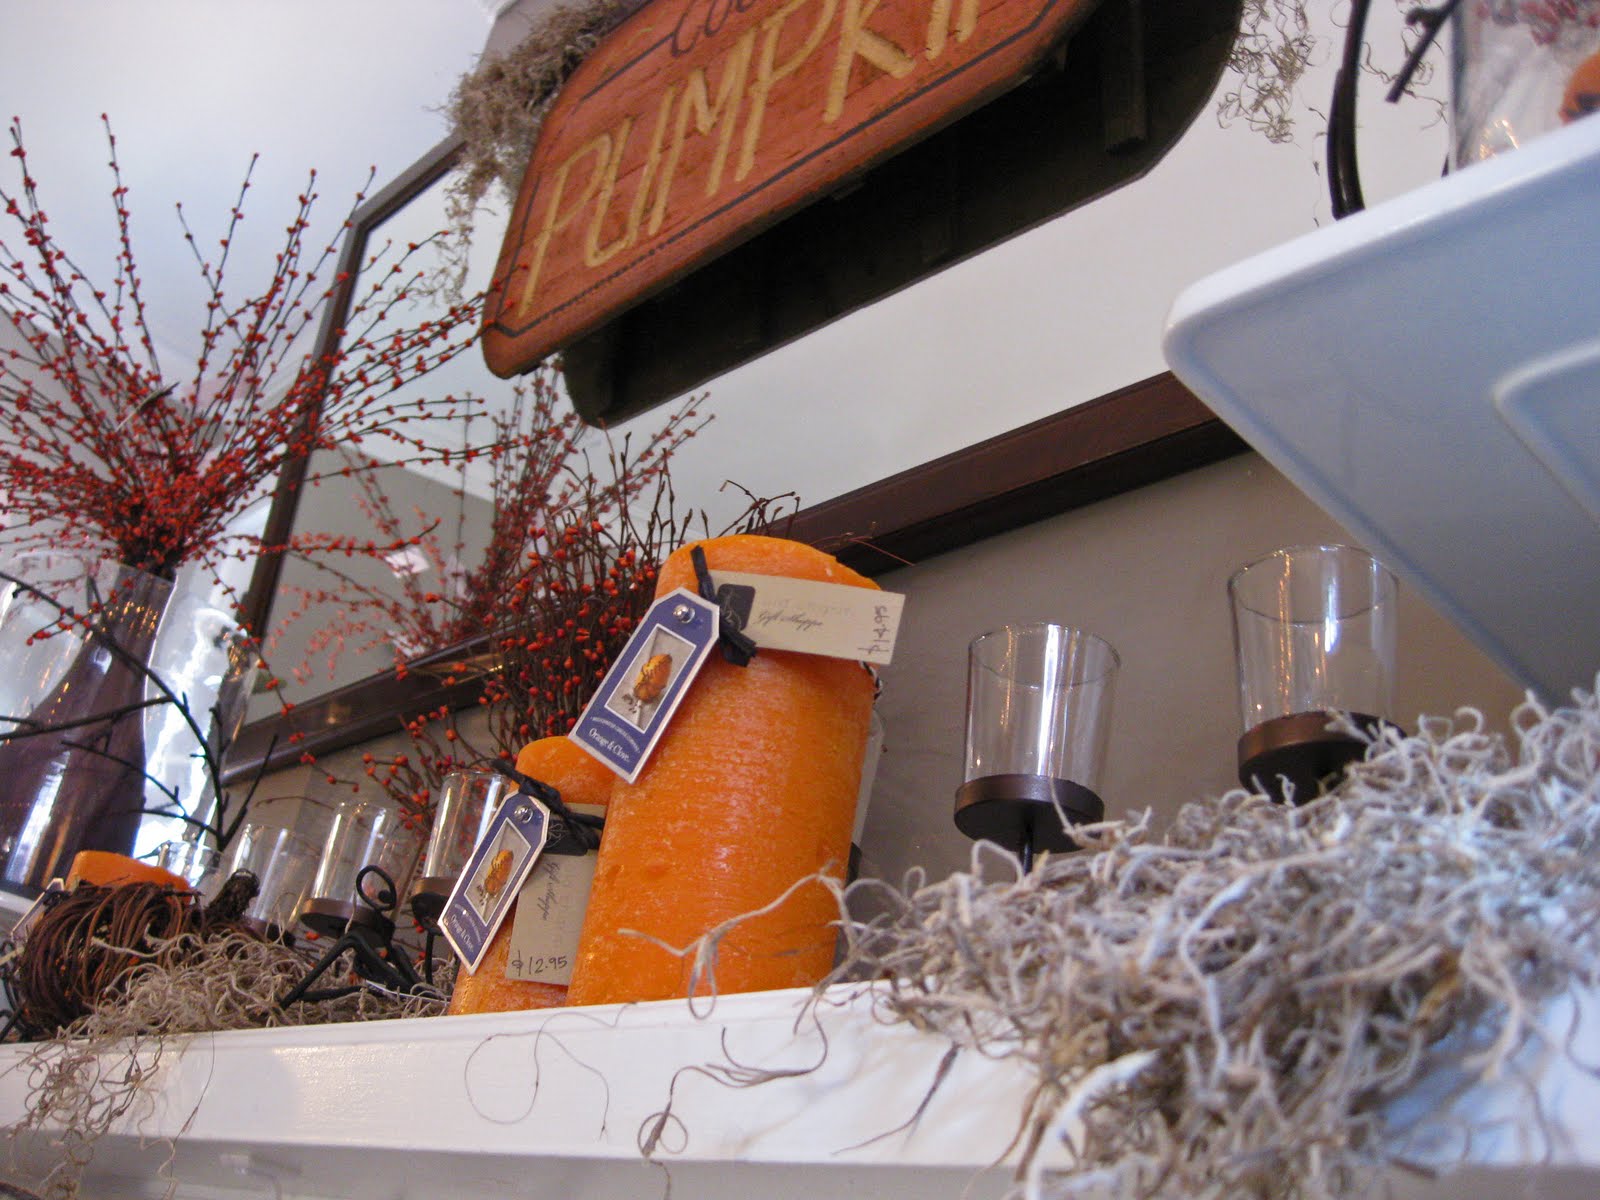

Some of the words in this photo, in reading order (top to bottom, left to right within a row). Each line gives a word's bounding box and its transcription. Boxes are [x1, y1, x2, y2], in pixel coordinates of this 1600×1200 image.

[516, 0, 978, 318] PUMPK
[588, 727, 609, 747] Orange
[511, 949, 568, 977] $12.95
